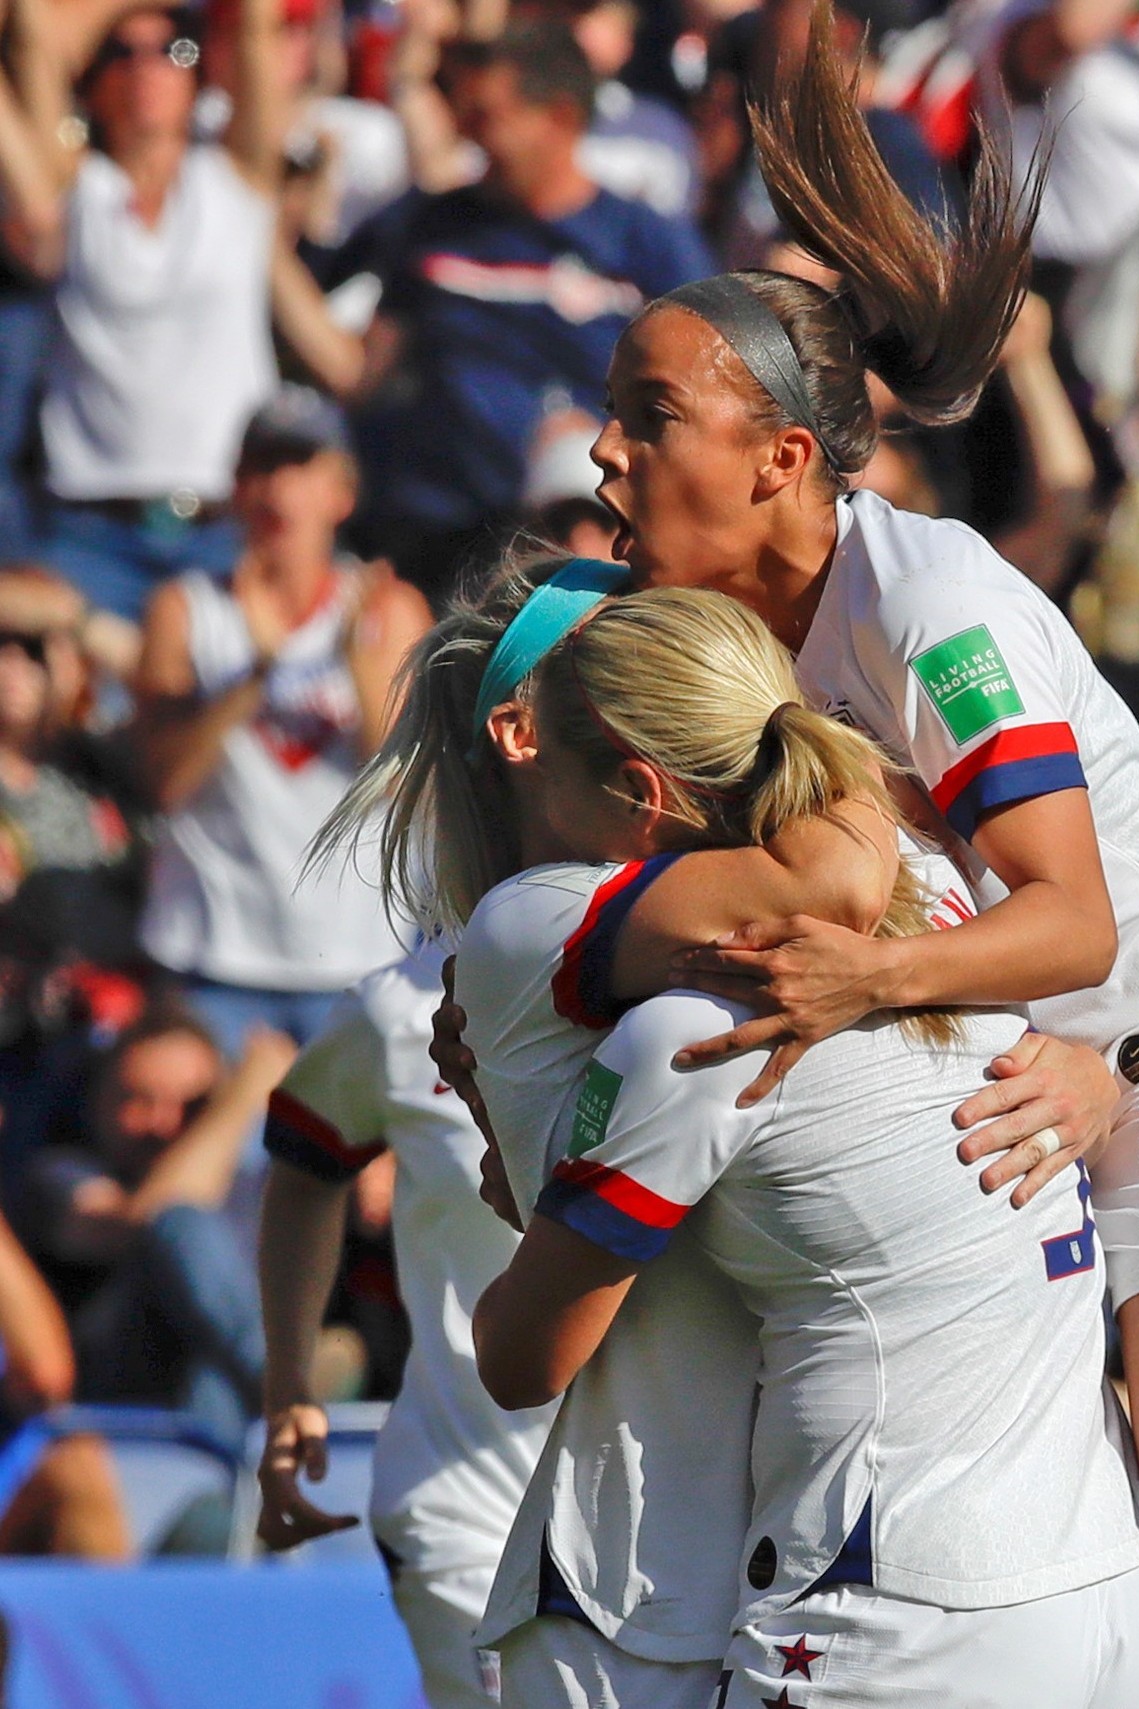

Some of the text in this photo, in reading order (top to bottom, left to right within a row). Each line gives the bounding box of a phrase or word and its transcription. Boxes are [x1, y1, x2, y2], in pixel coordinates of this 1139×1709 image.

[929, 649, 995, 689] LIVING
[935, 660, 1000, 699] FOOTBALL
[981, 678, 1010, 697] FIFA
